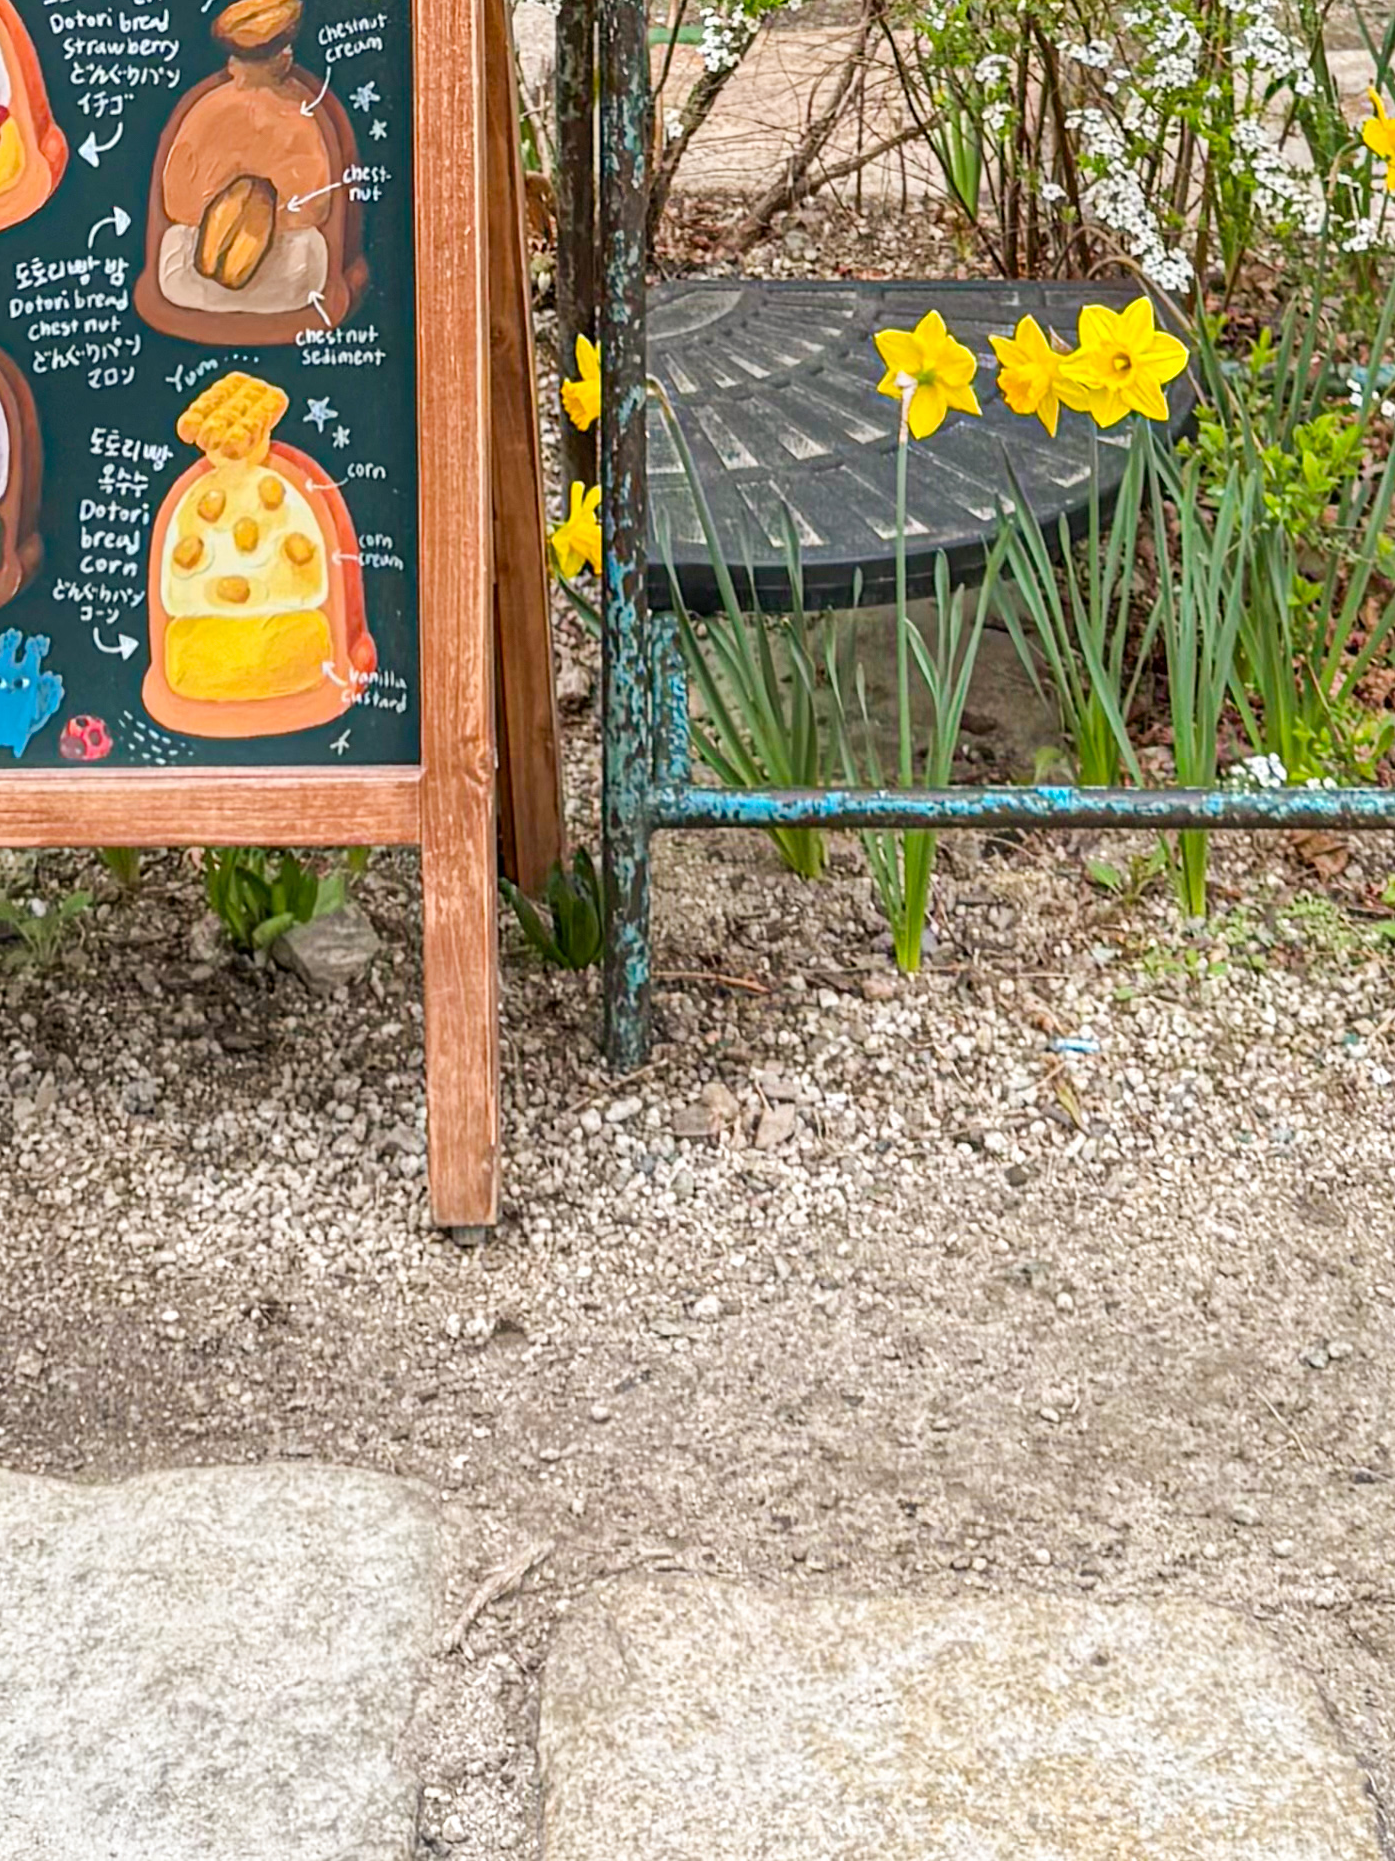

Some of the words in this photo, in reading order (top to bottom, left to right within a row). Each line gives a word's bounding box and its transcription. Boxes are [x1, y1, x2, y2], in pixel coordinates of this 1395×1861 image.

[50, 8, 112, 33] Dotori
[120, 9, 169, 32] bread
[350, 186, 381, 201] nut
[10, 290, 69, 318] Dotori
[75, 289, 128, 311] bread
[80, 499, 149, 524] Dotori
[81, 527, 139, 555] bread
